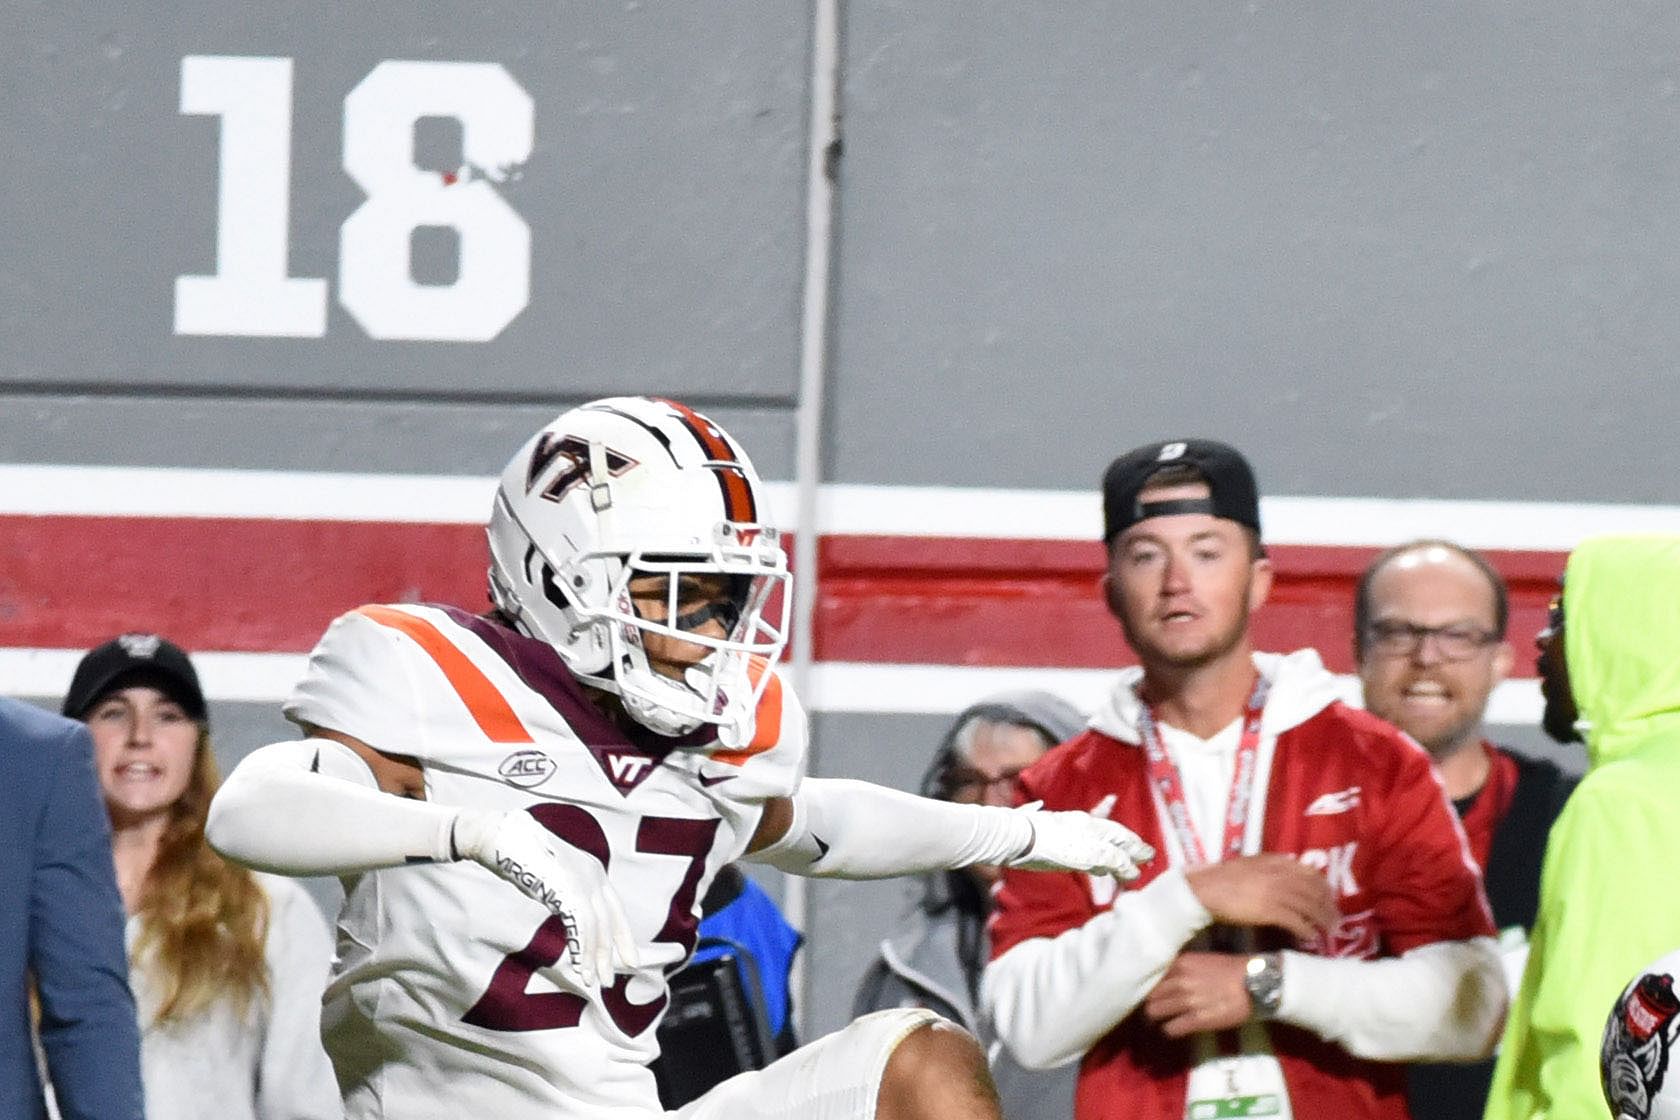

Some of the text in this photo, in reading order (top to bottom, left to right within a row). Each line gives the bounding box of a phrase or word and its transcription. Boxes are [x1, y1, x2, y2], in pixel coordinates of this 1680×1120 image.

[173, 56, 536, 342] 18
[508, 758, 548, 776] ACC
[607, 754, 654, 784] VT
[495, 849, 583, 976] VIRGINIA TECH
